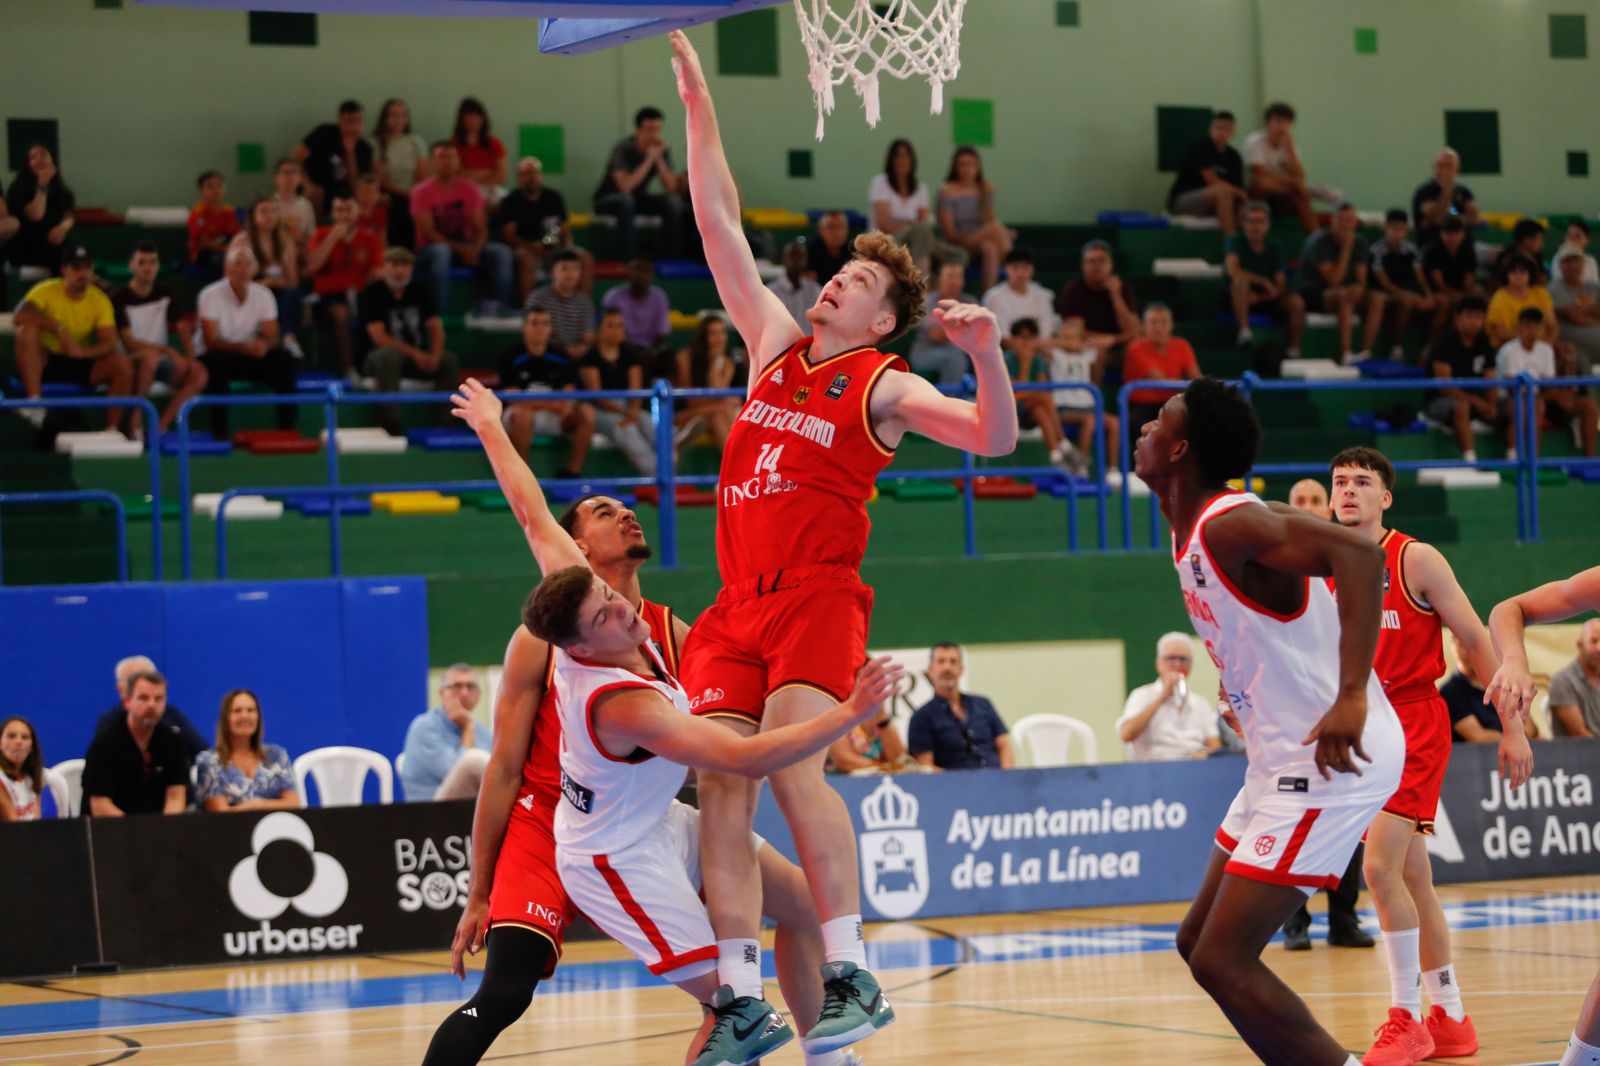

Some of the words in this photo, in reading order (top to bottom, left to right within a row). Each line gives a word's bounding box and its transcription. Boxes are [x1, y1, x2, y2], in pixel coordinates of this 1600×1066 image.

[754, 443, 785, 475] 14
[724, 477, 761, 507] ING
[561, 770, 588, 811] Bank
[1480, 768, 1592, 812] Junta
[947, 798, 1188, 851] Ayuntamiento
[1483, 815, 1532, 860] de
[394, 836, 472, 873] BAS
[951, 853, 994, 890] de
[1001, 852, 1042, 886] La
[1047, 846, 1140, 883] Línea
[525, 901, 557, 926] ING
[223, 919, 364, 957] urbaser
